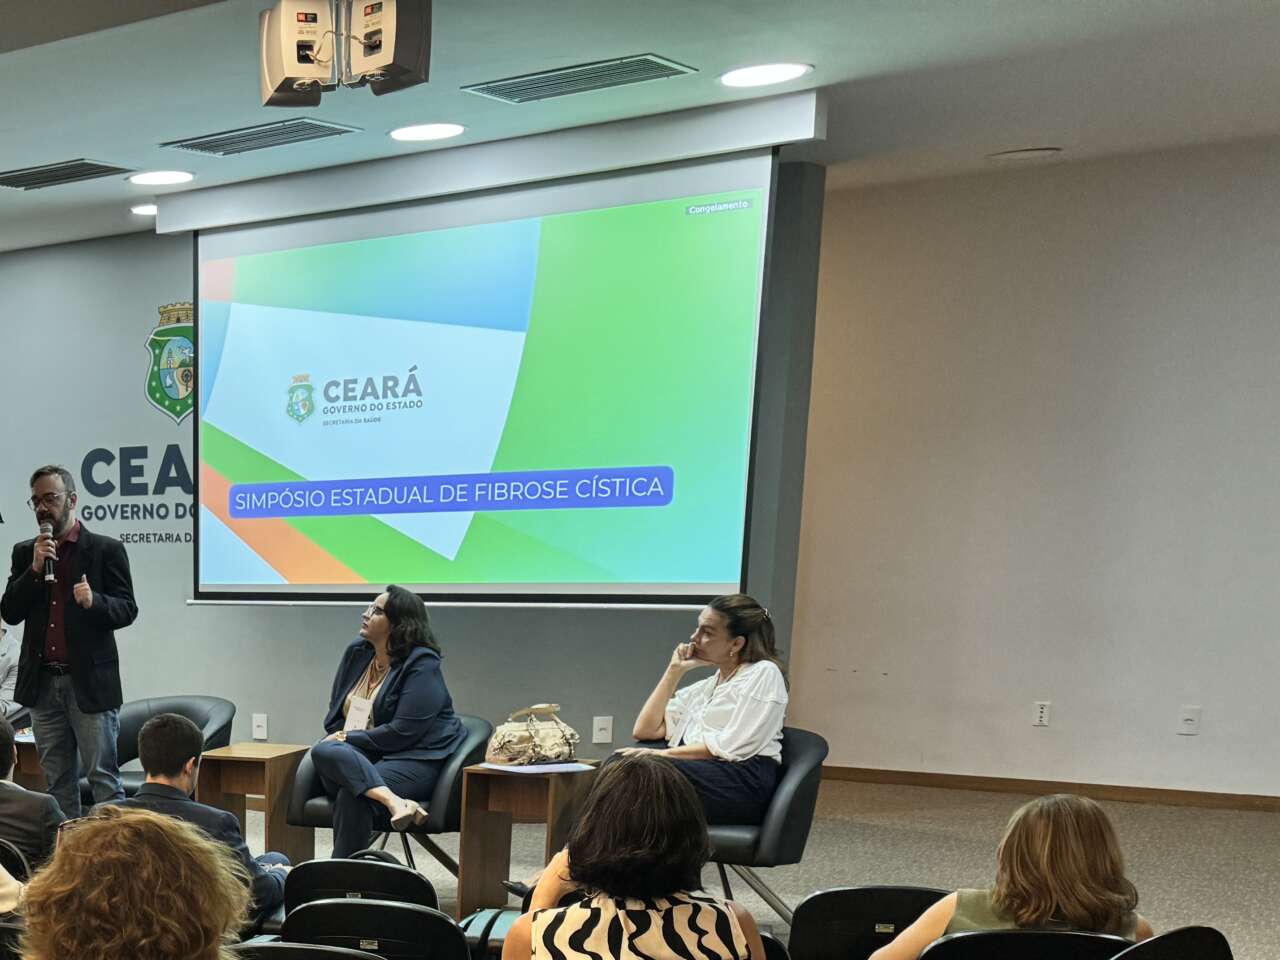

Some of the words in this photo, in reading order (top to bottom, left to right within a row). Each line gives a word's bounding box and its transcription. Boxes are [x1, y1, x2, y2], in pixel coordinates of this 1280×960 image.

[323, 364, 423, 403] CEARÁ
[322, 404, 367, 415] GOVERNO
[370, 402, 384, 412] DO
[386, 400, 423, 411] ESTADO
[235, 487, 325, 511] SIMPÓSIO
[330, 485, 434, 507] ESTADUAL
[440, 484, 469, 503] DE
[475, 480, 569, 502] FIBROSE
[575, 474, 664, 498] CÍSTICA
[81, 502, 170, 521] GOVERNO
[120, 532, 183, 543] SECRETARIA
[184, 532, 193, 543] D
